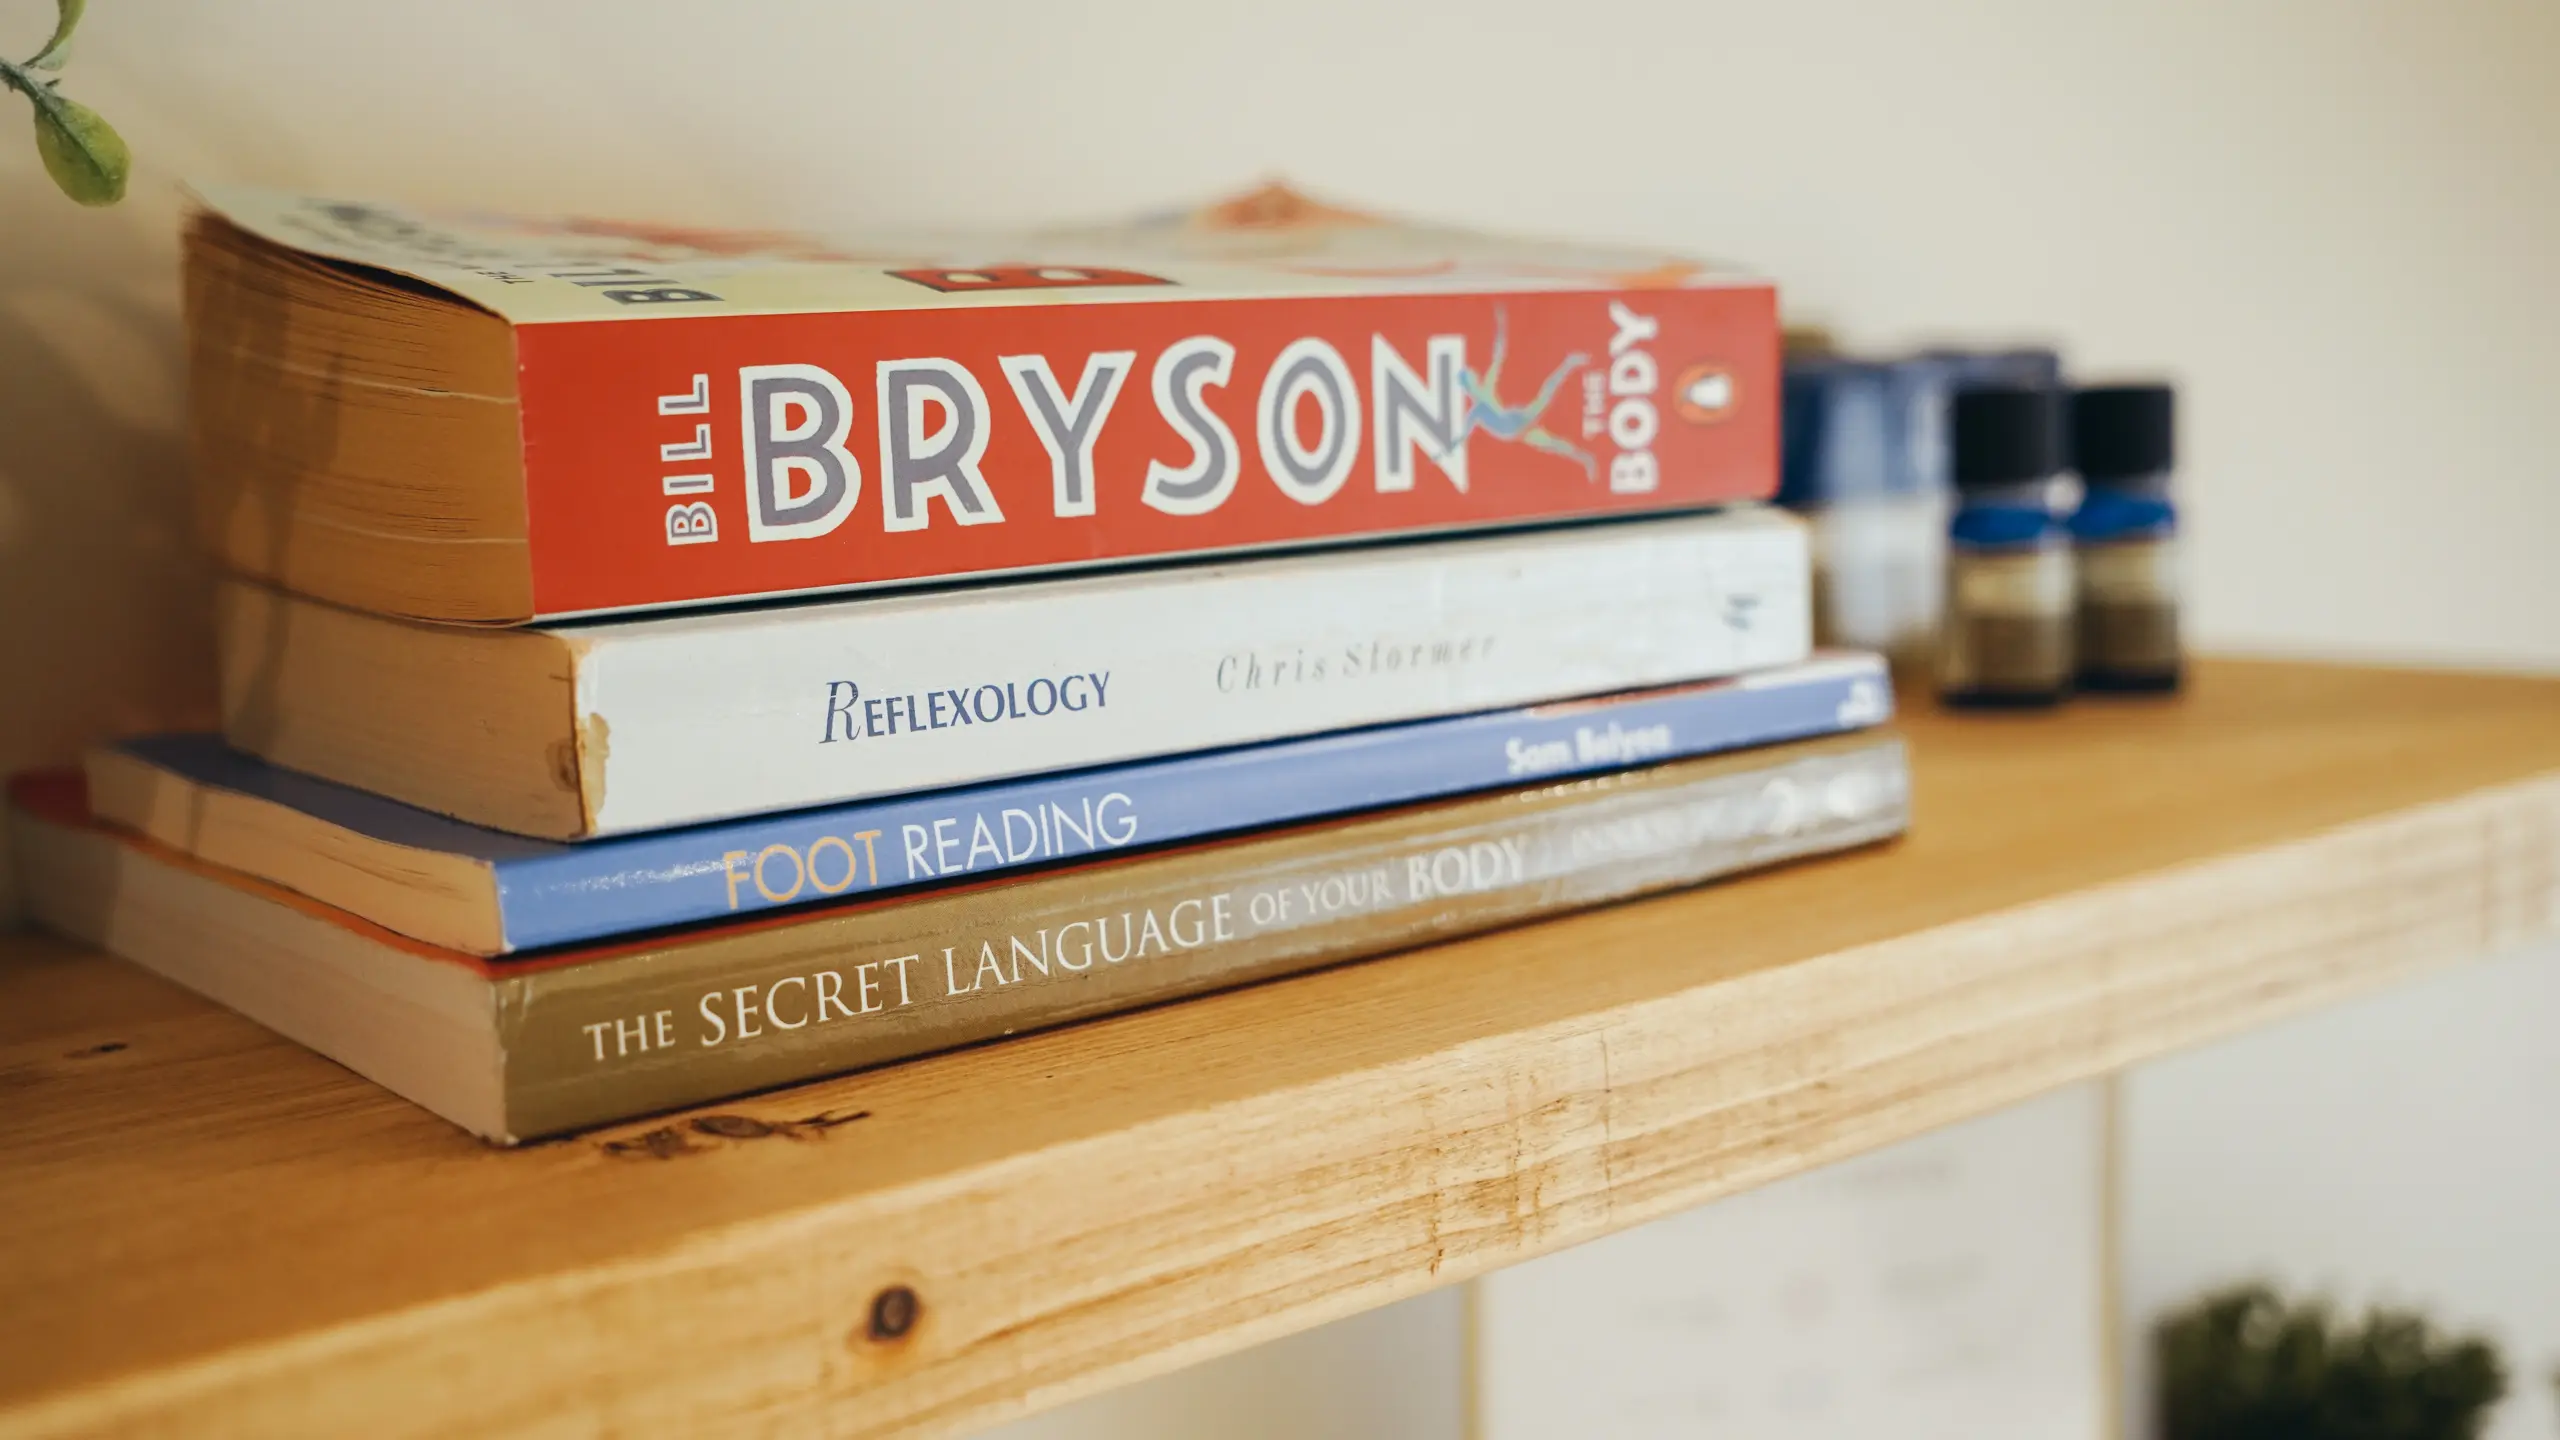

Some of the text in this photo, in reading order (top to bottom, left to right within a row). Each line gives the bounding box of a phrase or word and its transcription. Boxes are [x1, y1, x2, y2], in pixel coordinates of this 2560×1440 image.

[658, 332, 1468, 545] BILL BRYSON
[1582, 300, 1660, 494] THE BODY
[819, 671, 1110, 744] REFLEXOLOGY
[1217, 636, 1497, 693] Chris Stormer
[1505, 736, 1574, 776] Sam
[723, 793, 1138, 910] FOOT READING
[582, 833, 1526, 1061] THE SECRET LANGUAGE OF YOUR BODY
